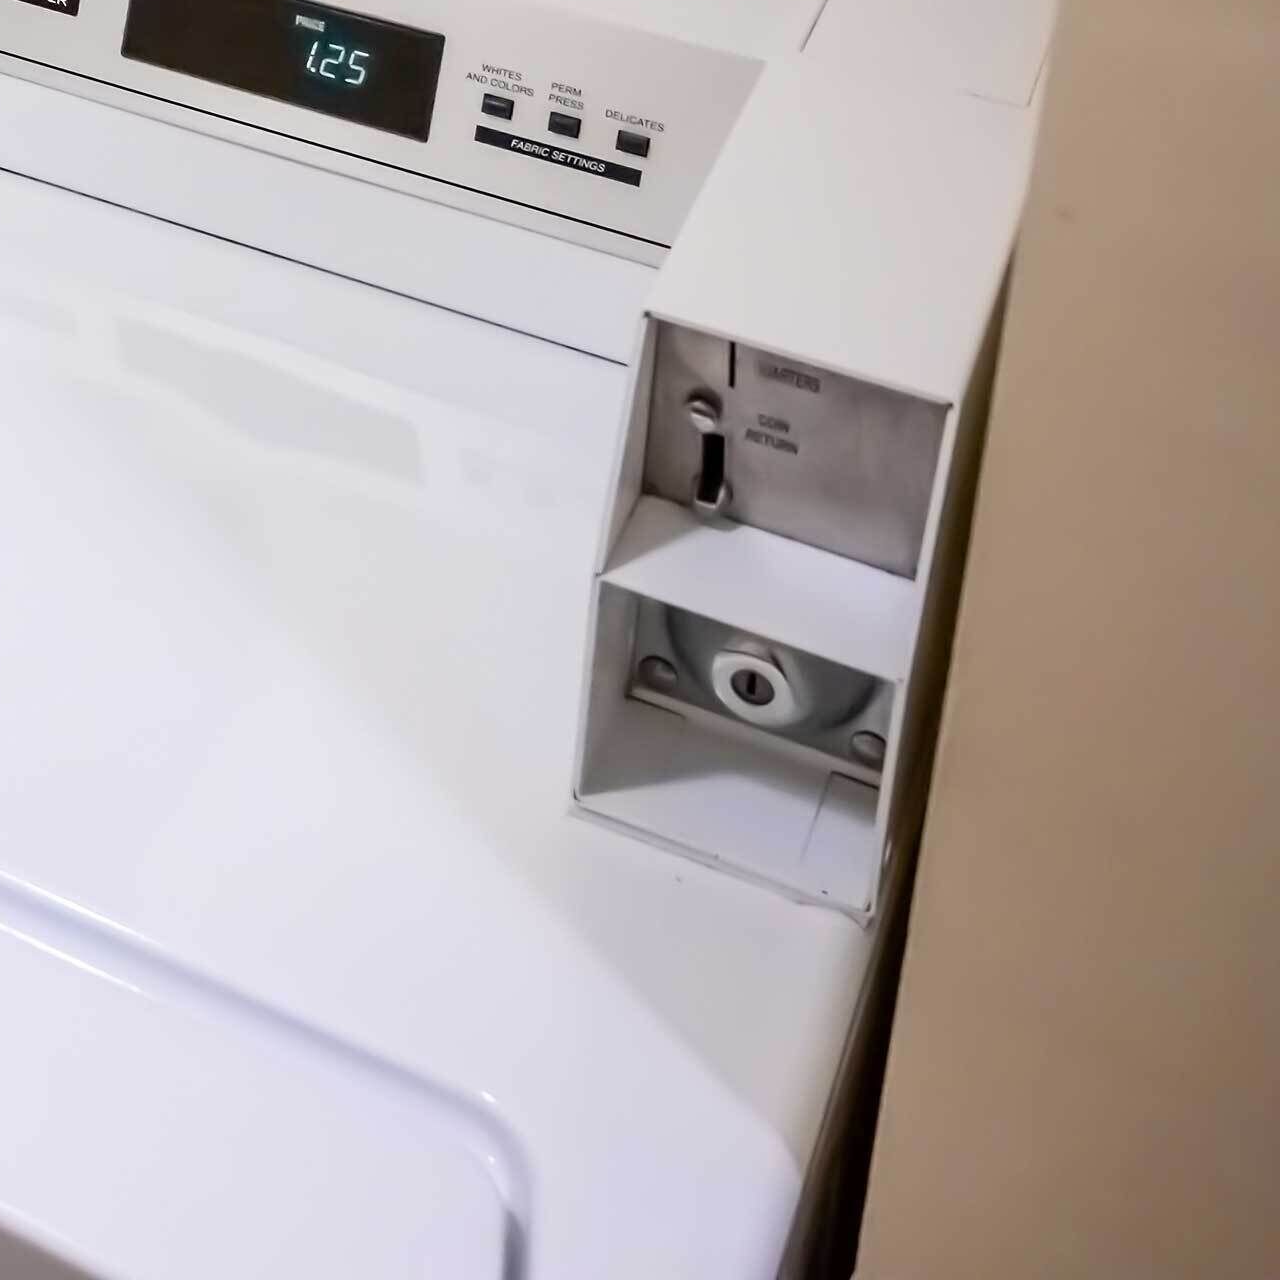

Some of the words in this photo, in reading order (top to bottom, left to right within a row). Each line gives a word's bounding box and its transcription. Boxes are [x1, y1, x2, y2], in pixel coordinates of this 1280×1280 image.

[306, 41, 370, 85] 1.25
[482, 64, 522, 81] WHITES
[465, 72, 488, 85] AND
[490, 78, 535, 97] COLORS
[551, 82, 582, 97] PERM
[548, 94, 585, 111] PRESS
[605, 109, 665, 132] DELICATES
[511, 139, 550, 157] FABRIC
[551, 151, 606, 173] SETTINGS
[745, 430, 799, 456] RETURN
